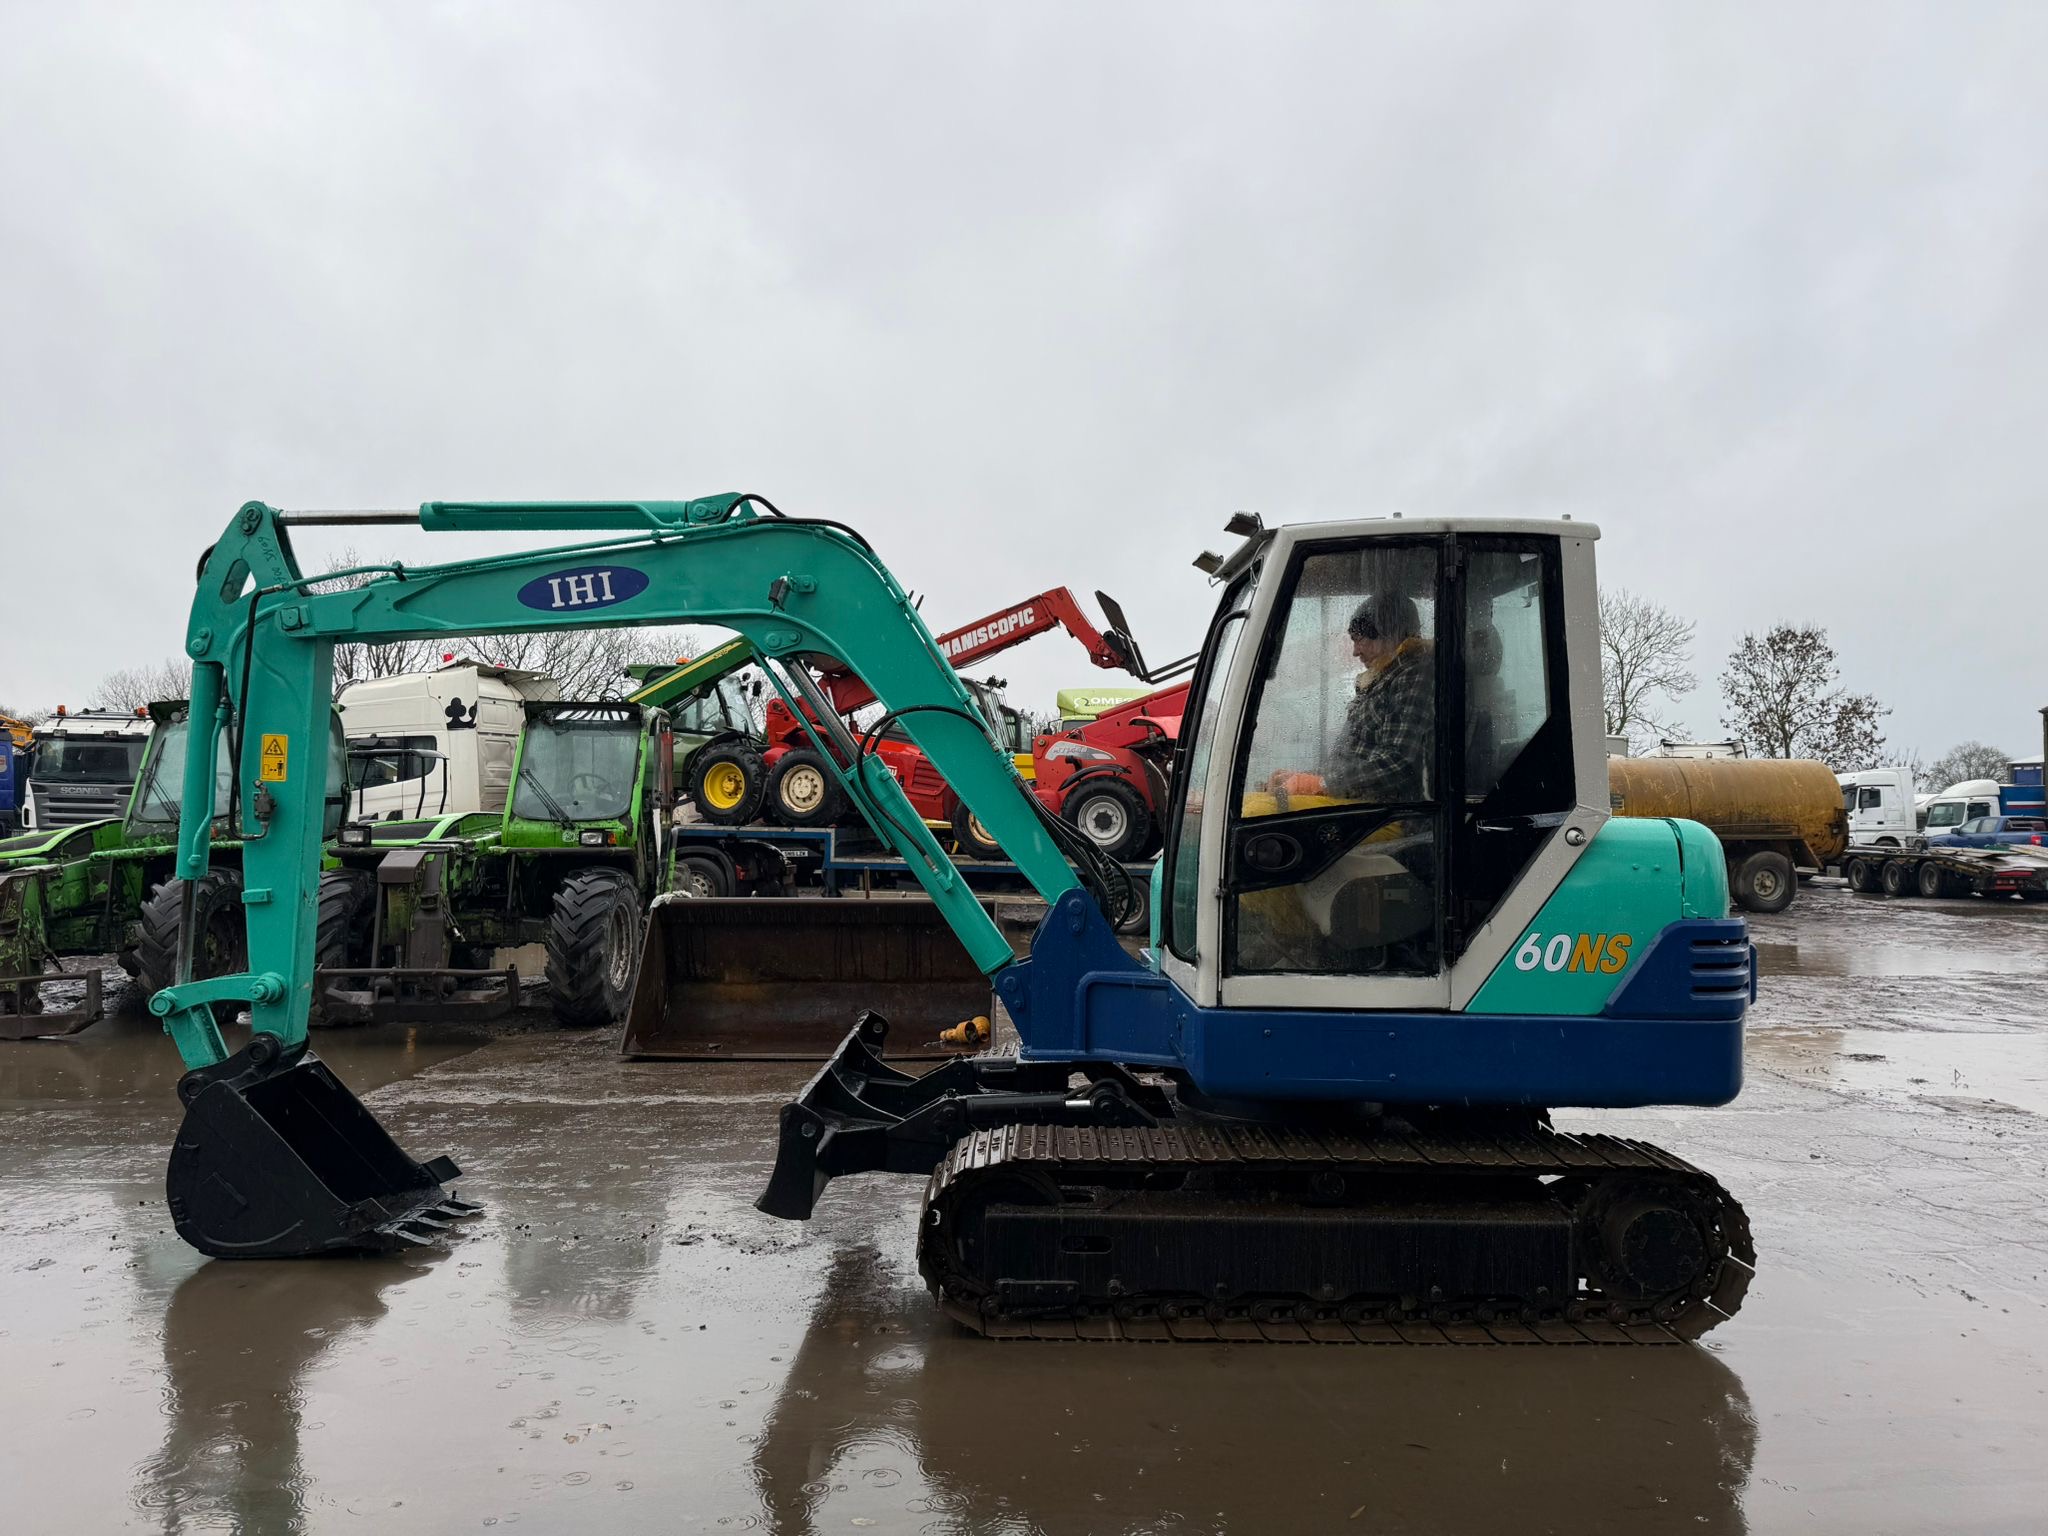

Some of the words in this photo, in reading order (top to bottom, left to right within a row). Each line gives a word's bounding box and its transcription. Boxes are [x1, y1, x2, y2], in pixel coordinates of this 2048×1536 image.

[548, 571, 615, 608] IHI
[939, 607, 1035, 658] MANISCOPIC
[60, 786, 101, 795] SCANIA
[1514, 932, 1633, 974] 60NS
